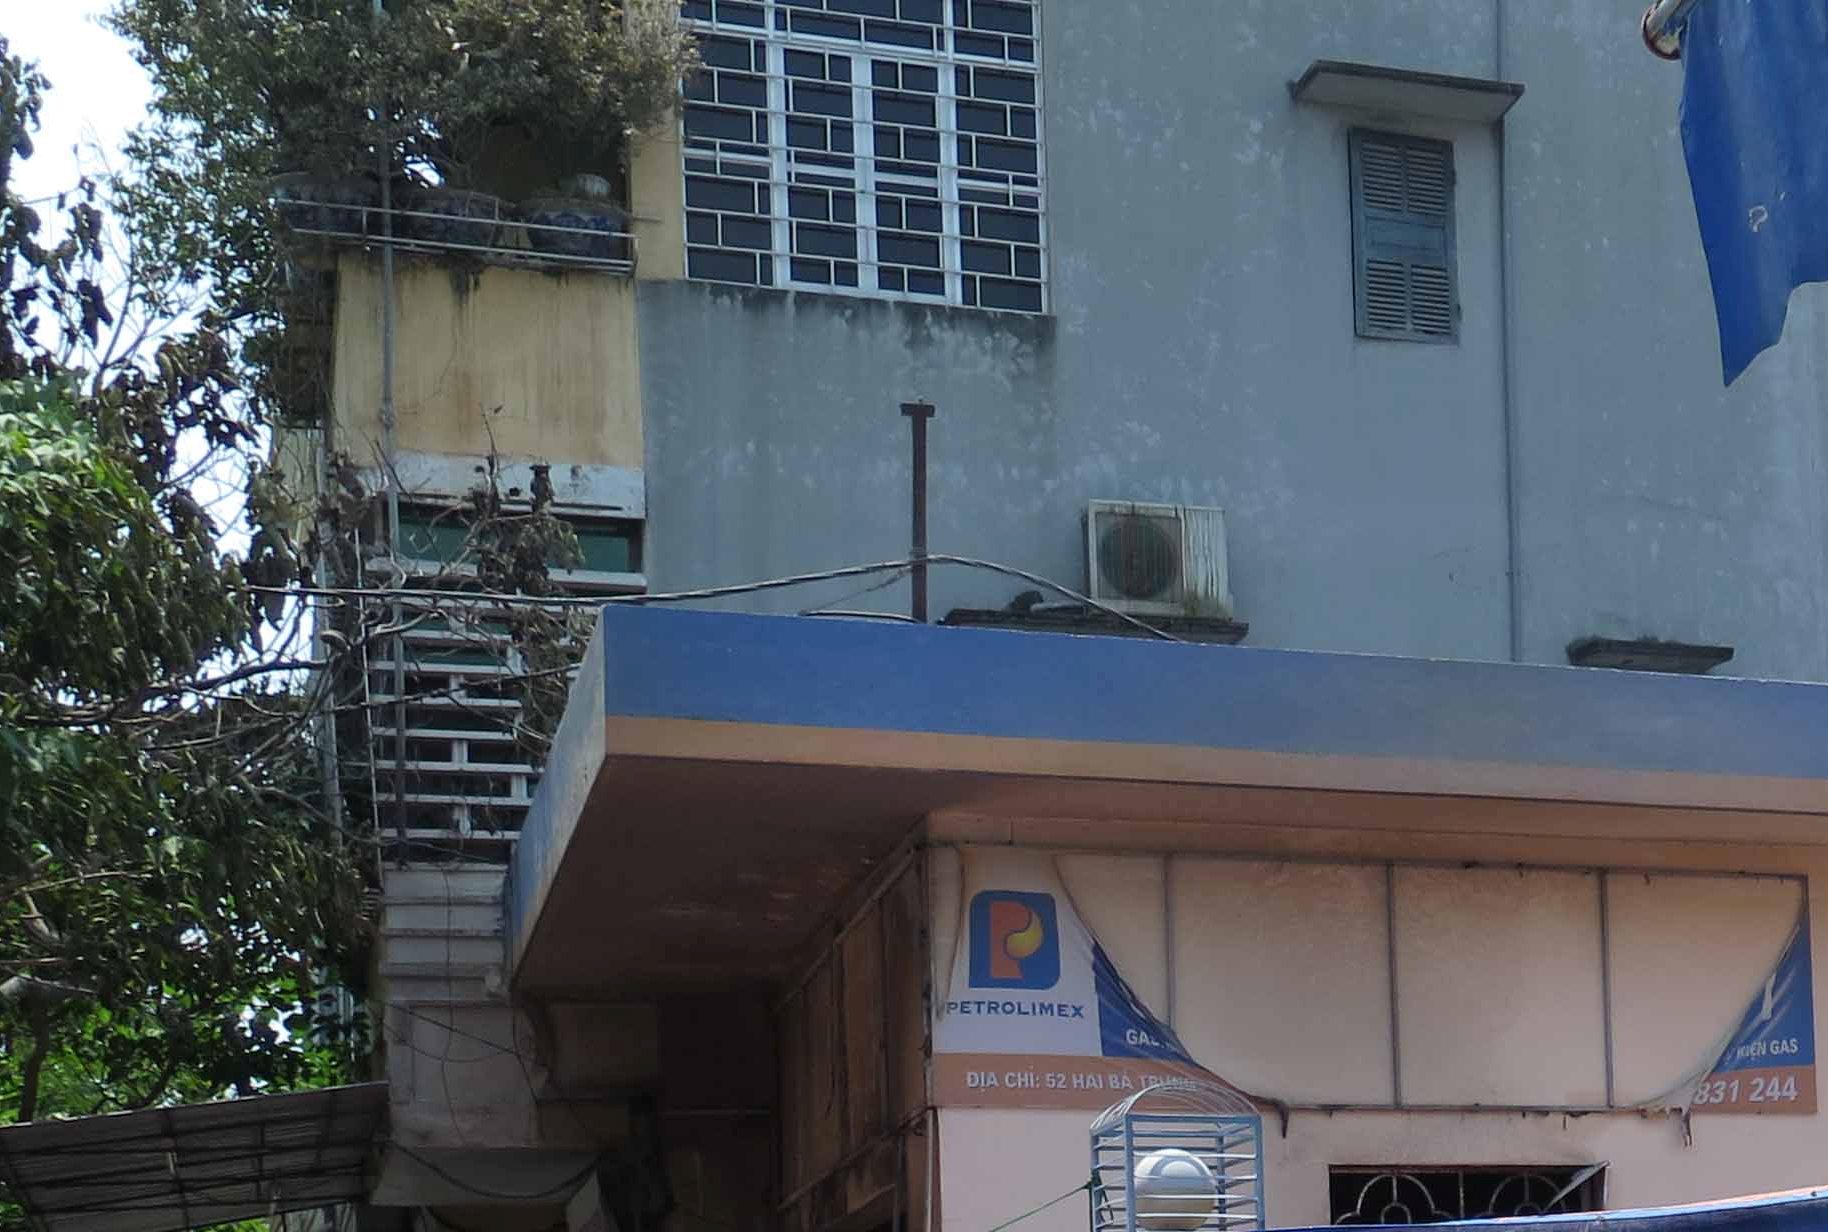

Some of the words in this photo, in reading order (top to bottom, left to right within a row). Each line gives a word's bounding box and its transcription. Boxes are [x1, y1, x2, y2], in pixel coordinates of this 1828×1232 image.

[946, 1000, 1084, 1019] PETROLIMEX
[1770, 1037, 1799, 1056] GAS
[966, 1071, 999, 1092] ĐỊA
[1046, 1072, 1067, 1089] 52
[1072, 1073, 1104, 1090] HAI
[1693, 1079, 1742, 1105] 831
[1749, 1075, 1799, 1103] 244
